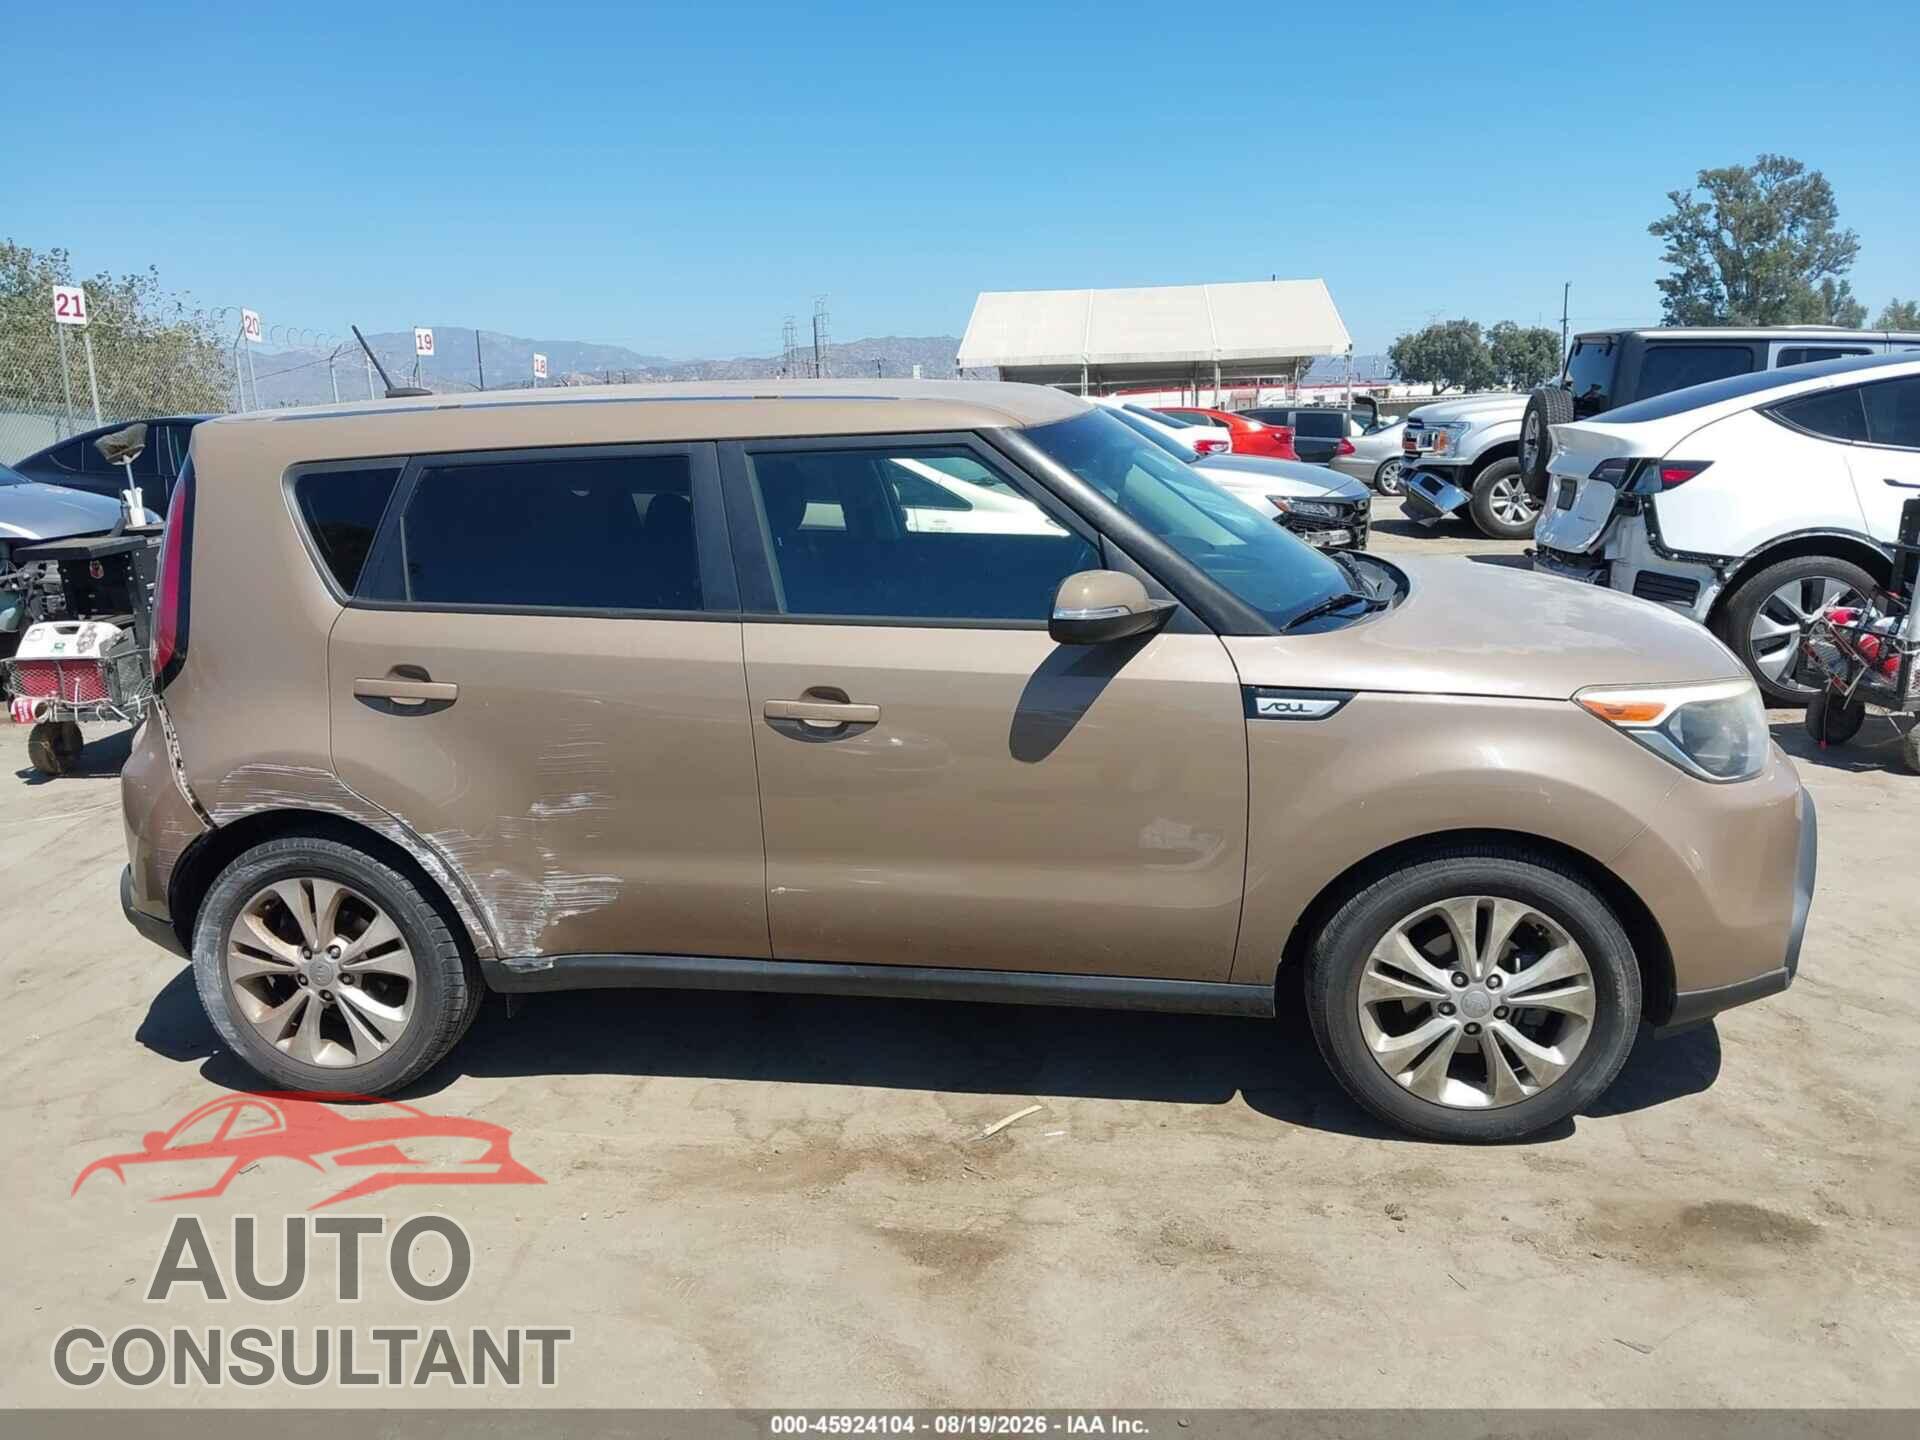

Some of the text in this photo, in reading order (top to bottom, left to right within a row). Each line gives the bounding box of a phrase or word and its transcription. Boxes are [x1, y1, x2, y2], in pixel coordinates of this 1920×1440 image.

[56, 293, 84, 318] 21
[245, 315, 260, 336] 20
[417, 334, 433, 351] 19
